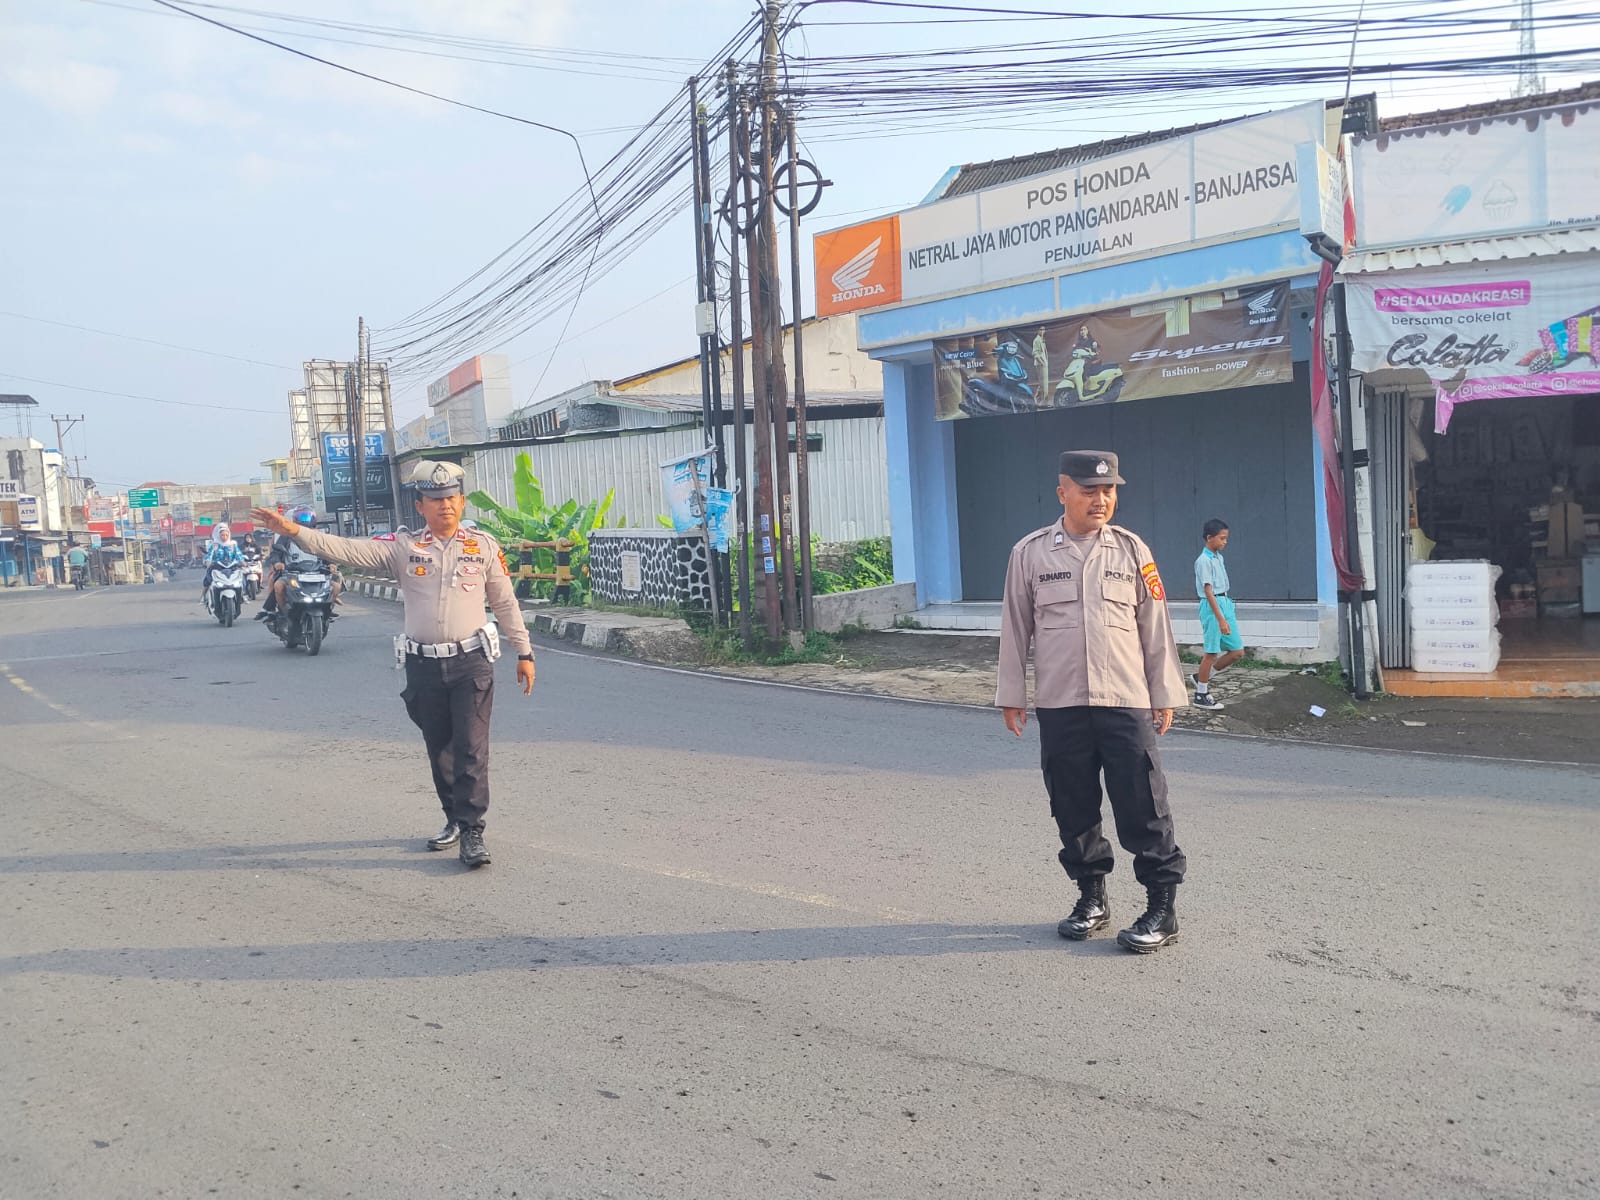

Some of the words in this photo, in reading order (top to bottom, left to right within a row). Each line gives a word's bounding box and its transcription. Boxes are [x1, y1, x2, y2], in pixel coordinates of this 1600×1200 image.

[1027, 182, 1067, 209] POS
[1074, 162, 1150, 197] HONDA
[909, 241, 959, 270] NETRAL
[962, 232, 995, 257] JAYA
[1000, 218, 1051, 250] MOTOR
[1055, 188, 1178, 236] PANGANDARAN
[1195, 159, 1297, 205] BANJARSA
[1045, 232, 1133, 263] PENJUALAN
[831, 283, 885, 303] HONDA
[1380, 288, 1524, 307] #SELALUADAKREASI
[1392, 315, 1453, 326] bersama
[1457, 311, 1511, 324] cokelat
[1387, 333, 1510, 368] Colatta
[966, 360, 984, 368] Blue
[1162, 365, 1200, 378] fashion
[1215, 360, 1249, 371] POWER
[330, 436, 378, 448] ROL
[333, 471, 383, 484] Serity
[457, 556, 484, 564] POLRI
[1039, 571, 1072, 582] SUNARTO
[1105, 570, 1134, 583] POLRI
